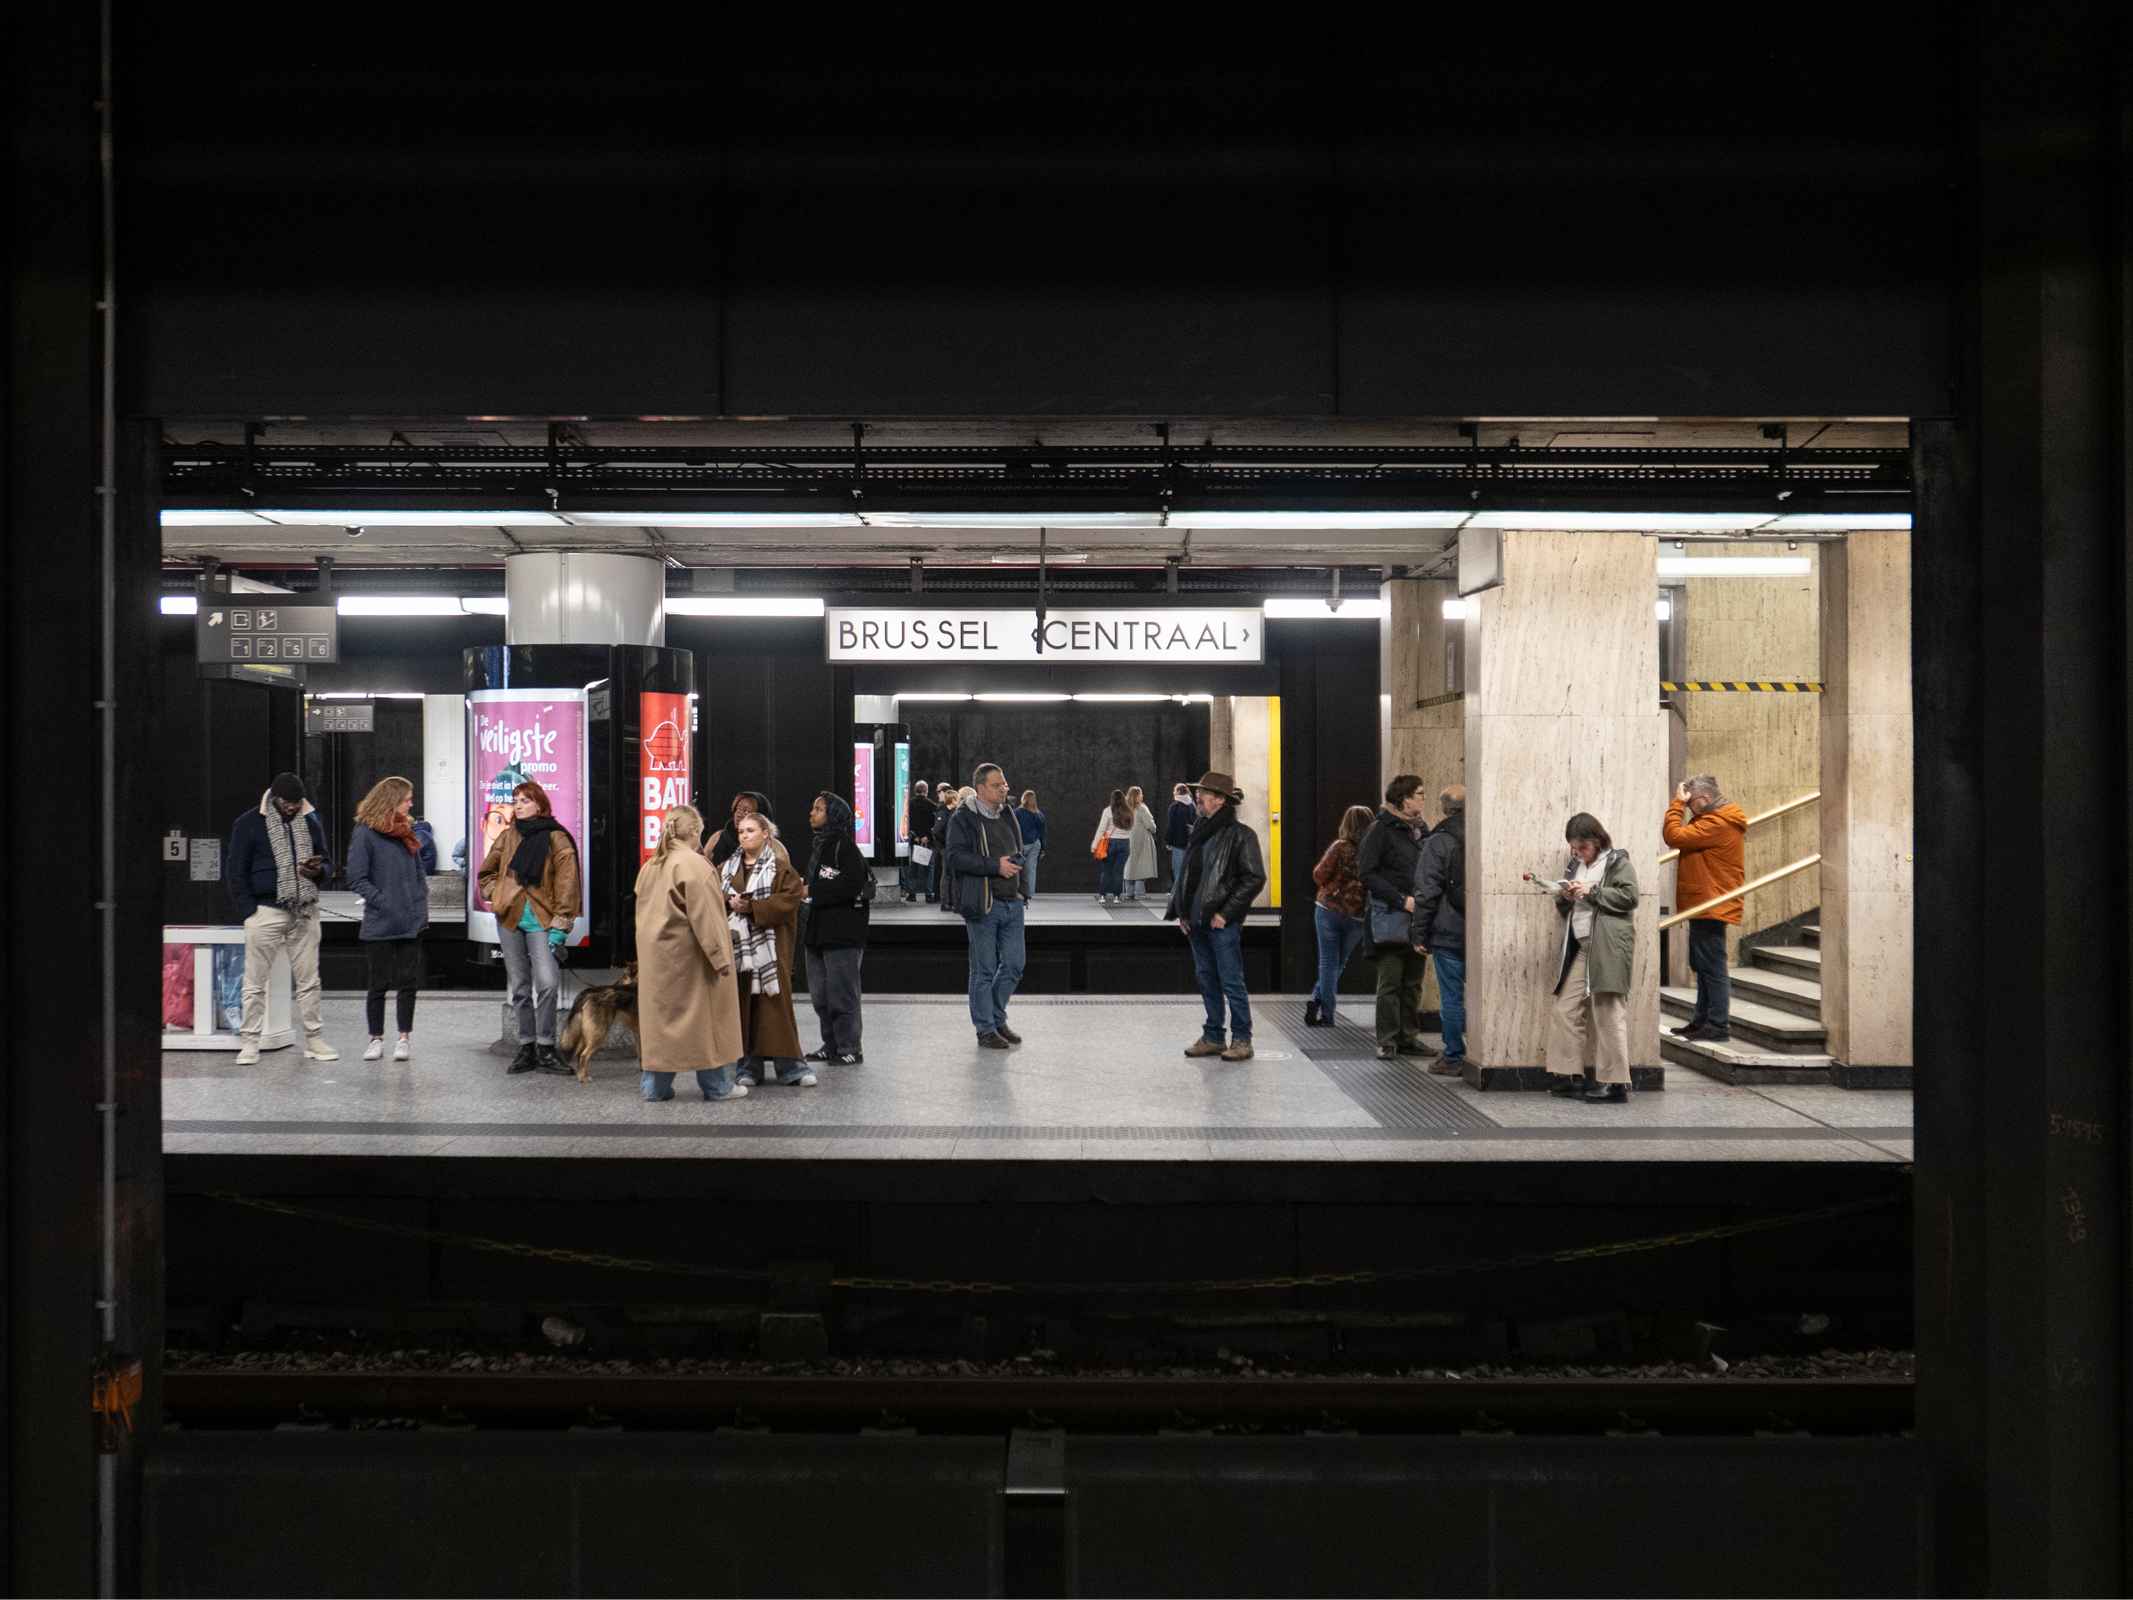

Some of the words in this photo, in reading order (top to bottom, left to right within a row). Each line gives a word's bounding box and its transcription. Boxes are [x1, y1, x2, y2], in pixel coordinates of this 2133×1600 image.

[838, 620, 998, 650] BRUSSEL
[1043, 620, 1237, 650] CENTRAAL
[243, 645, 249, 655] 1
[267, 645, 274, 655] 2
[293, 645, 300, 655] 5
[318, 645, 326, 655] 6
[480, 714, 489, 726] De
[480, 719, 557, 766] veiligste
[521, 762, 557, 775] promo
[170, 841, 179, 857] 5
